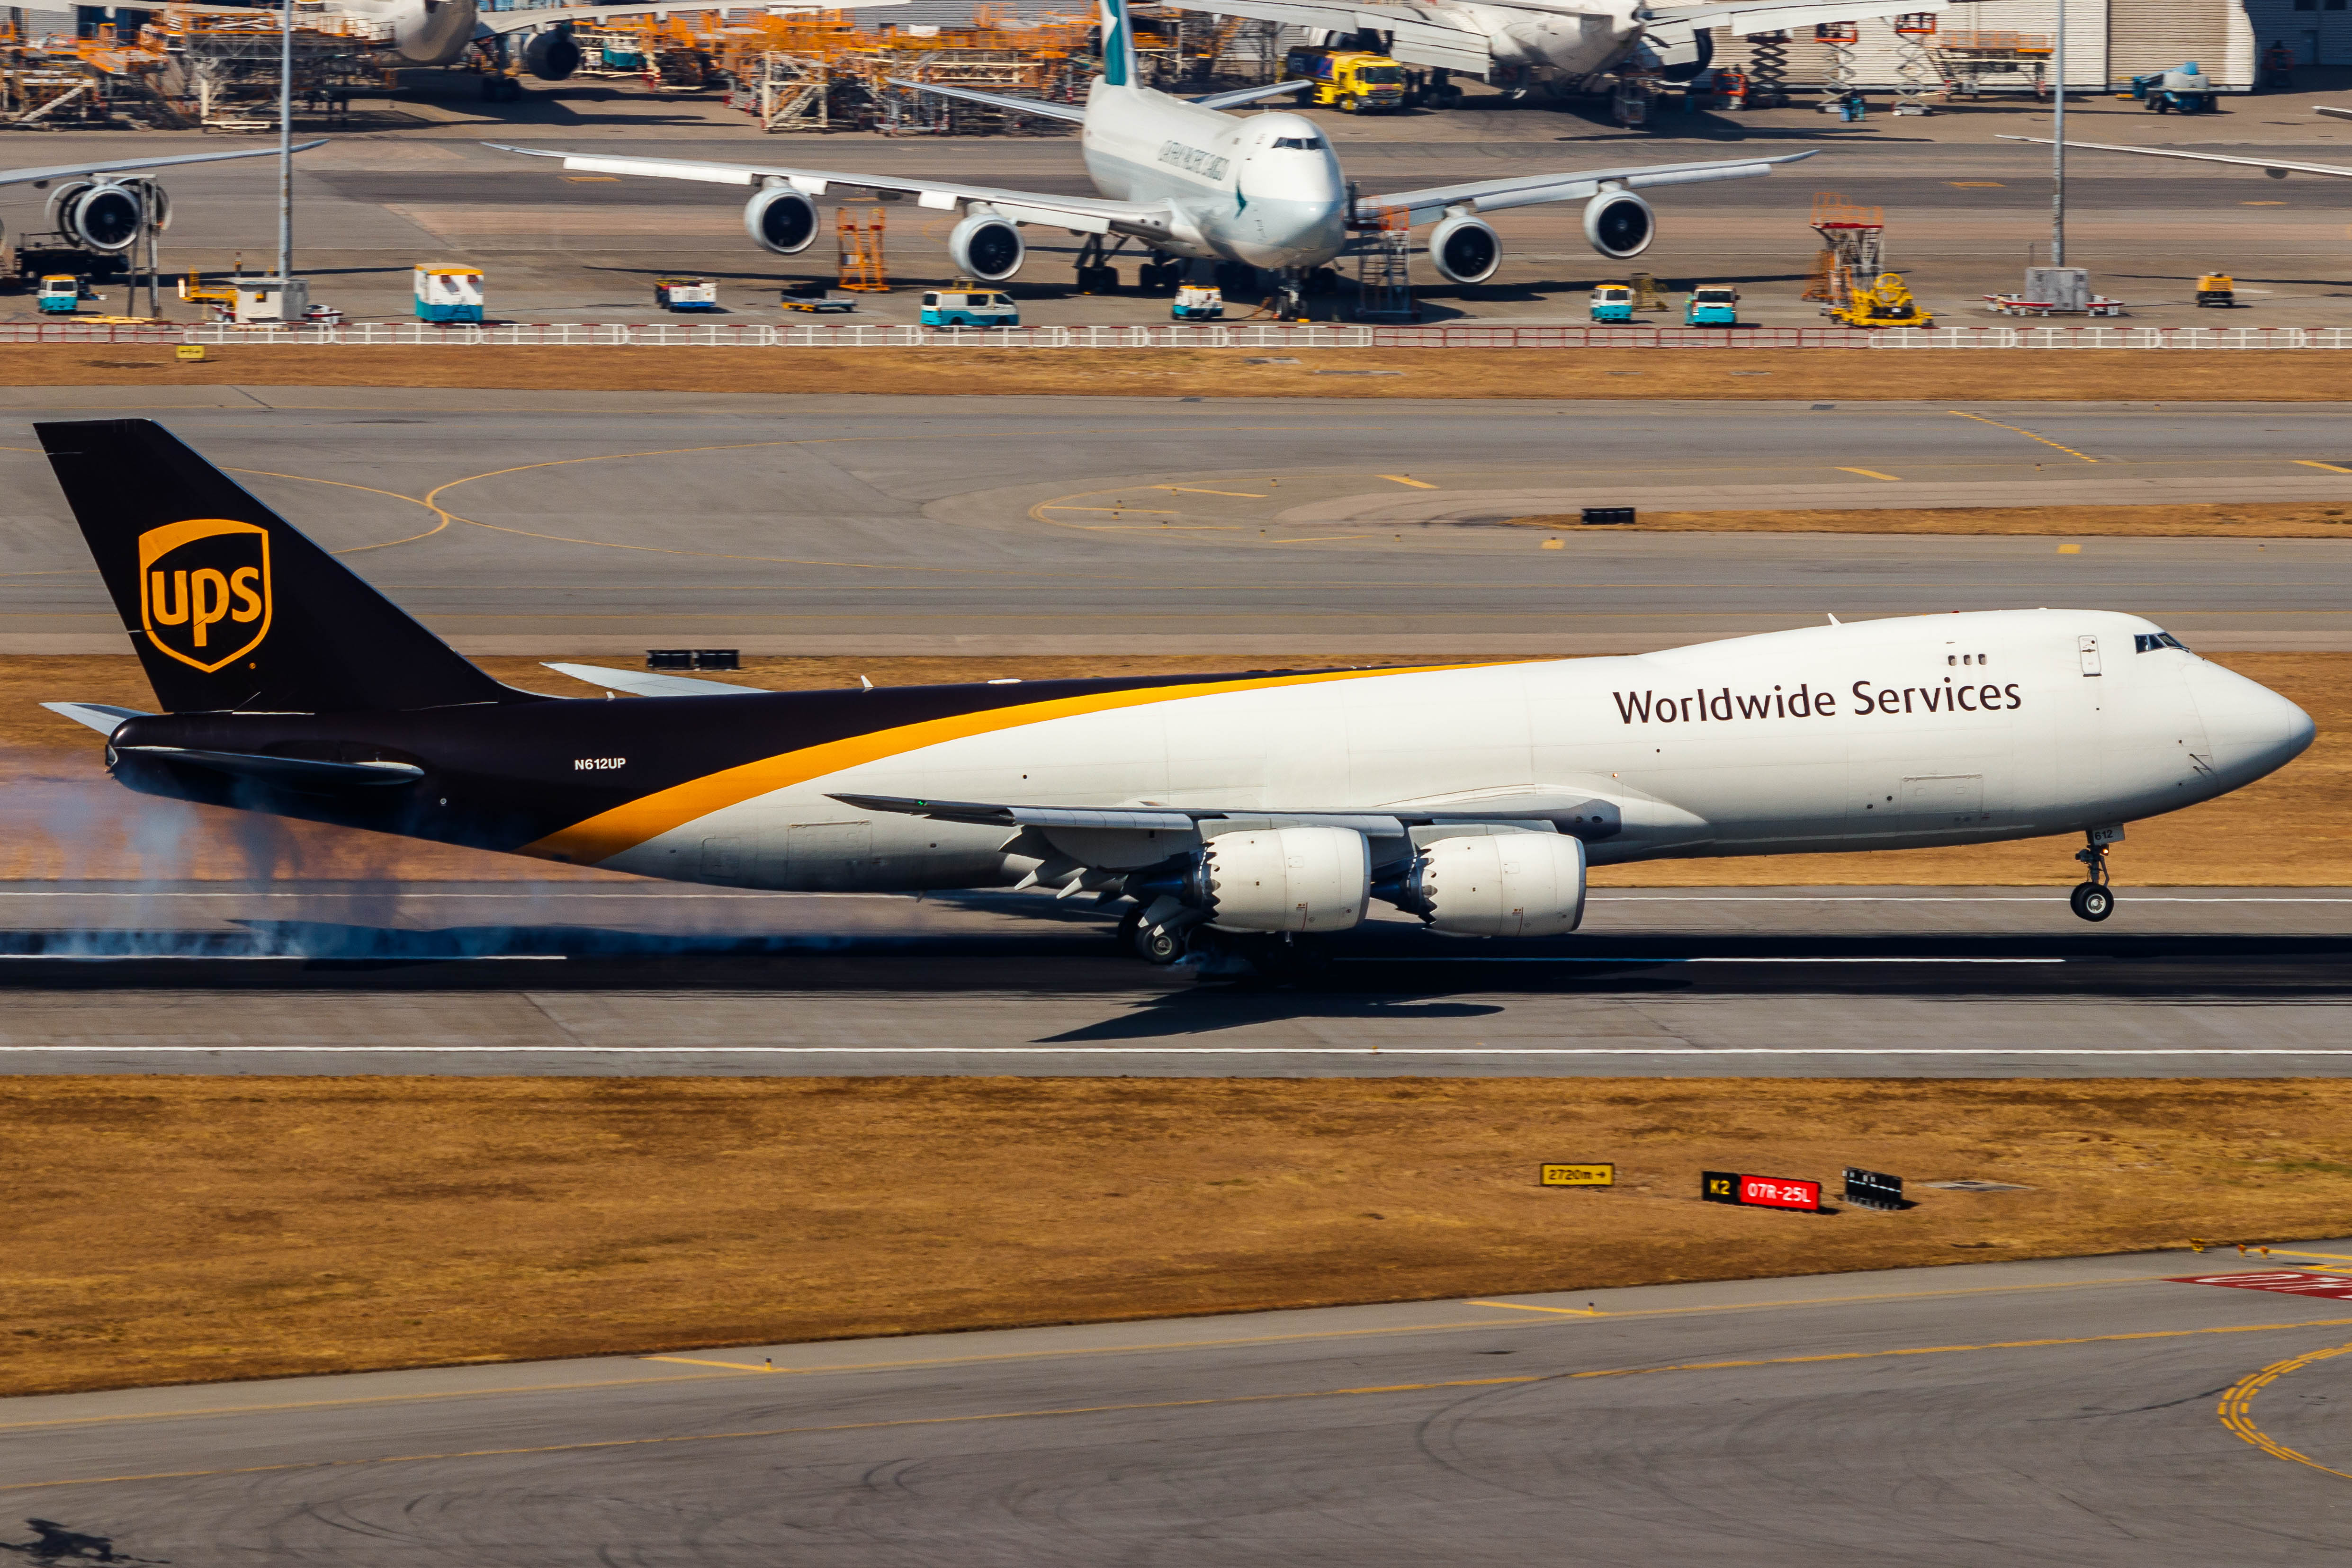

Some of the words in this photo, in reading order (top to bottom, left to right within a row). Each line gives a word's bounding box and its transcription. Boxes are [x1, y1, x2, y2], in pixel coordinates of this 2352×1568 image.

[151, 566, 262, 647] ups
[1612, 683, 1836, 724] Worldwide
[1852, 676, 2021, 716] Services
[574, 757, 626, 771] N612UP
[2094, 829, 2114, 841] 612
[1548, 1169, 1593, 1180] 2720m
[1710, 1179, 1731, 1195] K2
[1747, 1183, 1812, 1203] 07R-25L
